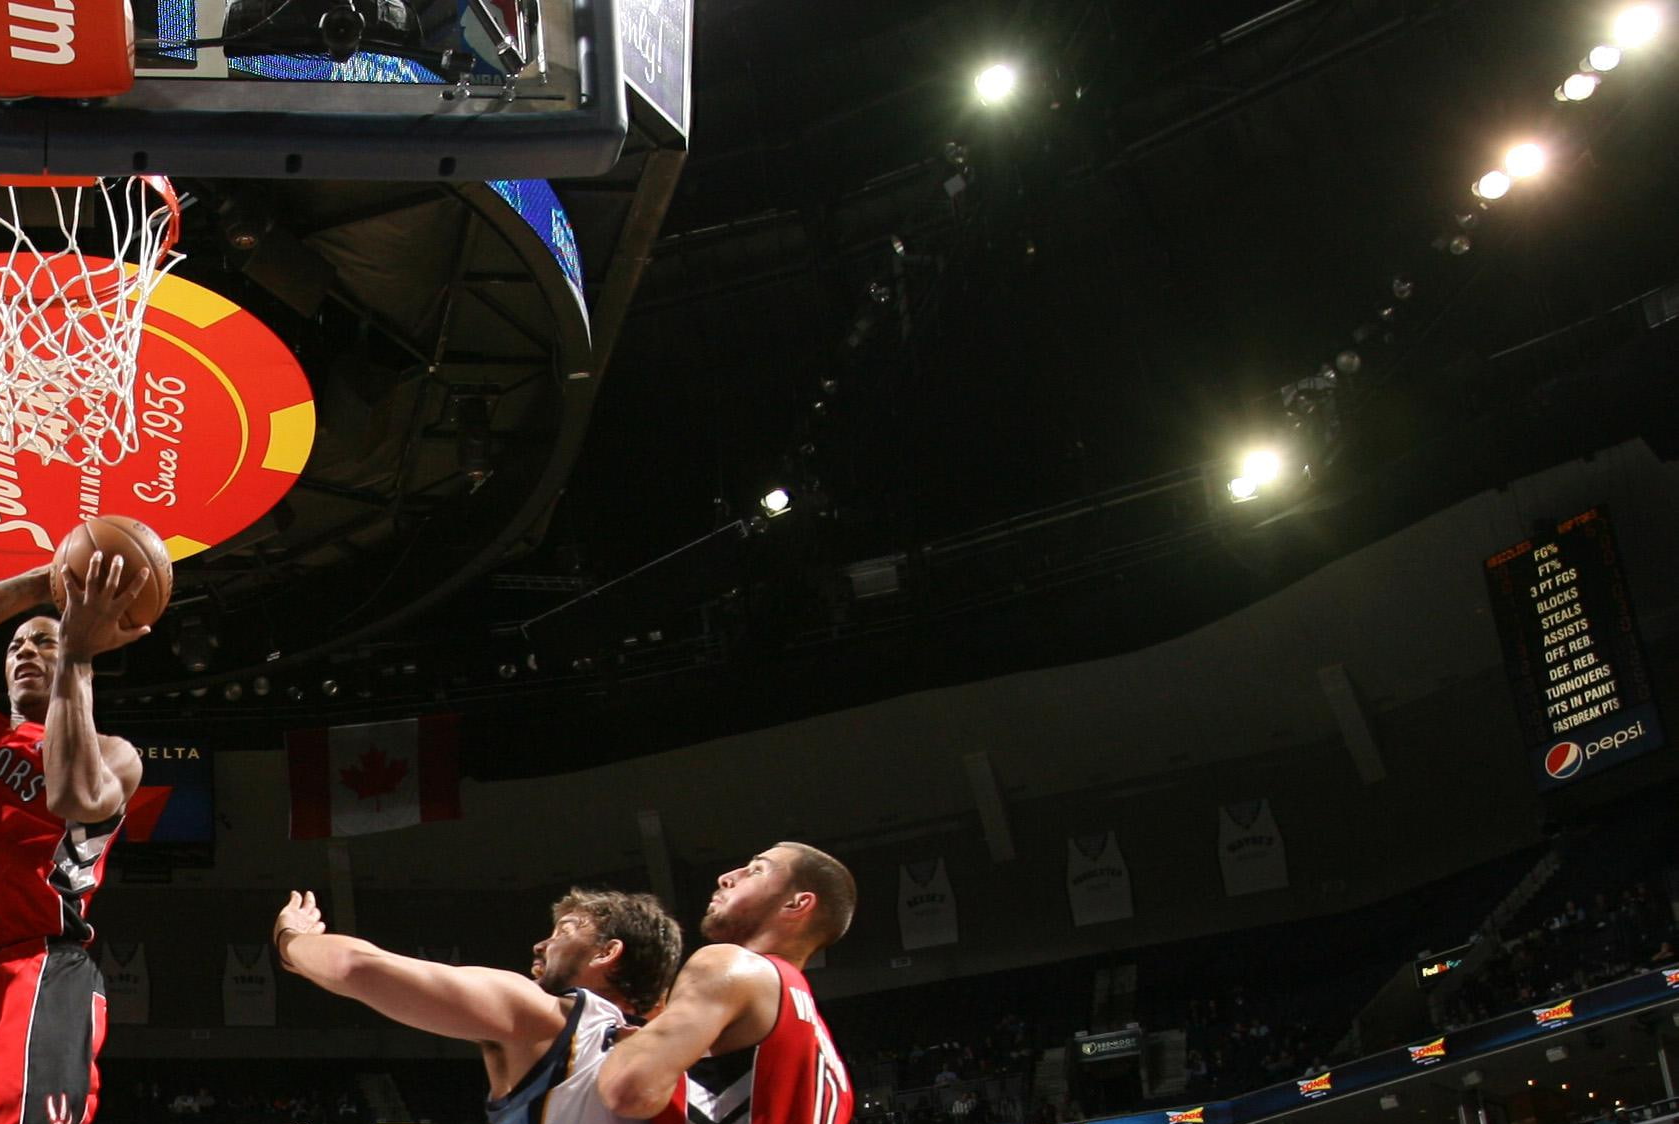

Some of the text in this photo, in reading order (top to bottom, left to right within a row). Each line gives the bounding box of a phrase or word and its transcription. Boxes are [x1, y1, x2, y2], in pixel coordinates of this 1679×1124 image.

[142, 371, 186, 444] 1956
[133, 448, 177, 506] Since
[1534, 543, 1558, 561] FG%
[1538, 559, 1561, 577] FT%
[1530, 568, 1577, 598] 3 PT FGS
[1537, 587, 1579, 614] BLOCKS
[1541, 602, 1582, 629] STEALS
[1544, 618, 1588, 647] ASSISTS
[1545, 635, 1594, 663] OFF. REB.
[1549, 653, 1598, 681] DEF. REB.
[1546, 664, 1610, 700] TURNOVERS
[1547, 680, 1616, 718] PTS IN PAINT
[1553, 697, 1620, 734] FASTBREAK PTS
[1585, 721, 1642, 760] pepsi
[1411, 1043, 1444, 1058] SONIC
[1300, 1077, 1331, 1093] SONIC
[1169, 1112, 1203, 1122] SONIC
